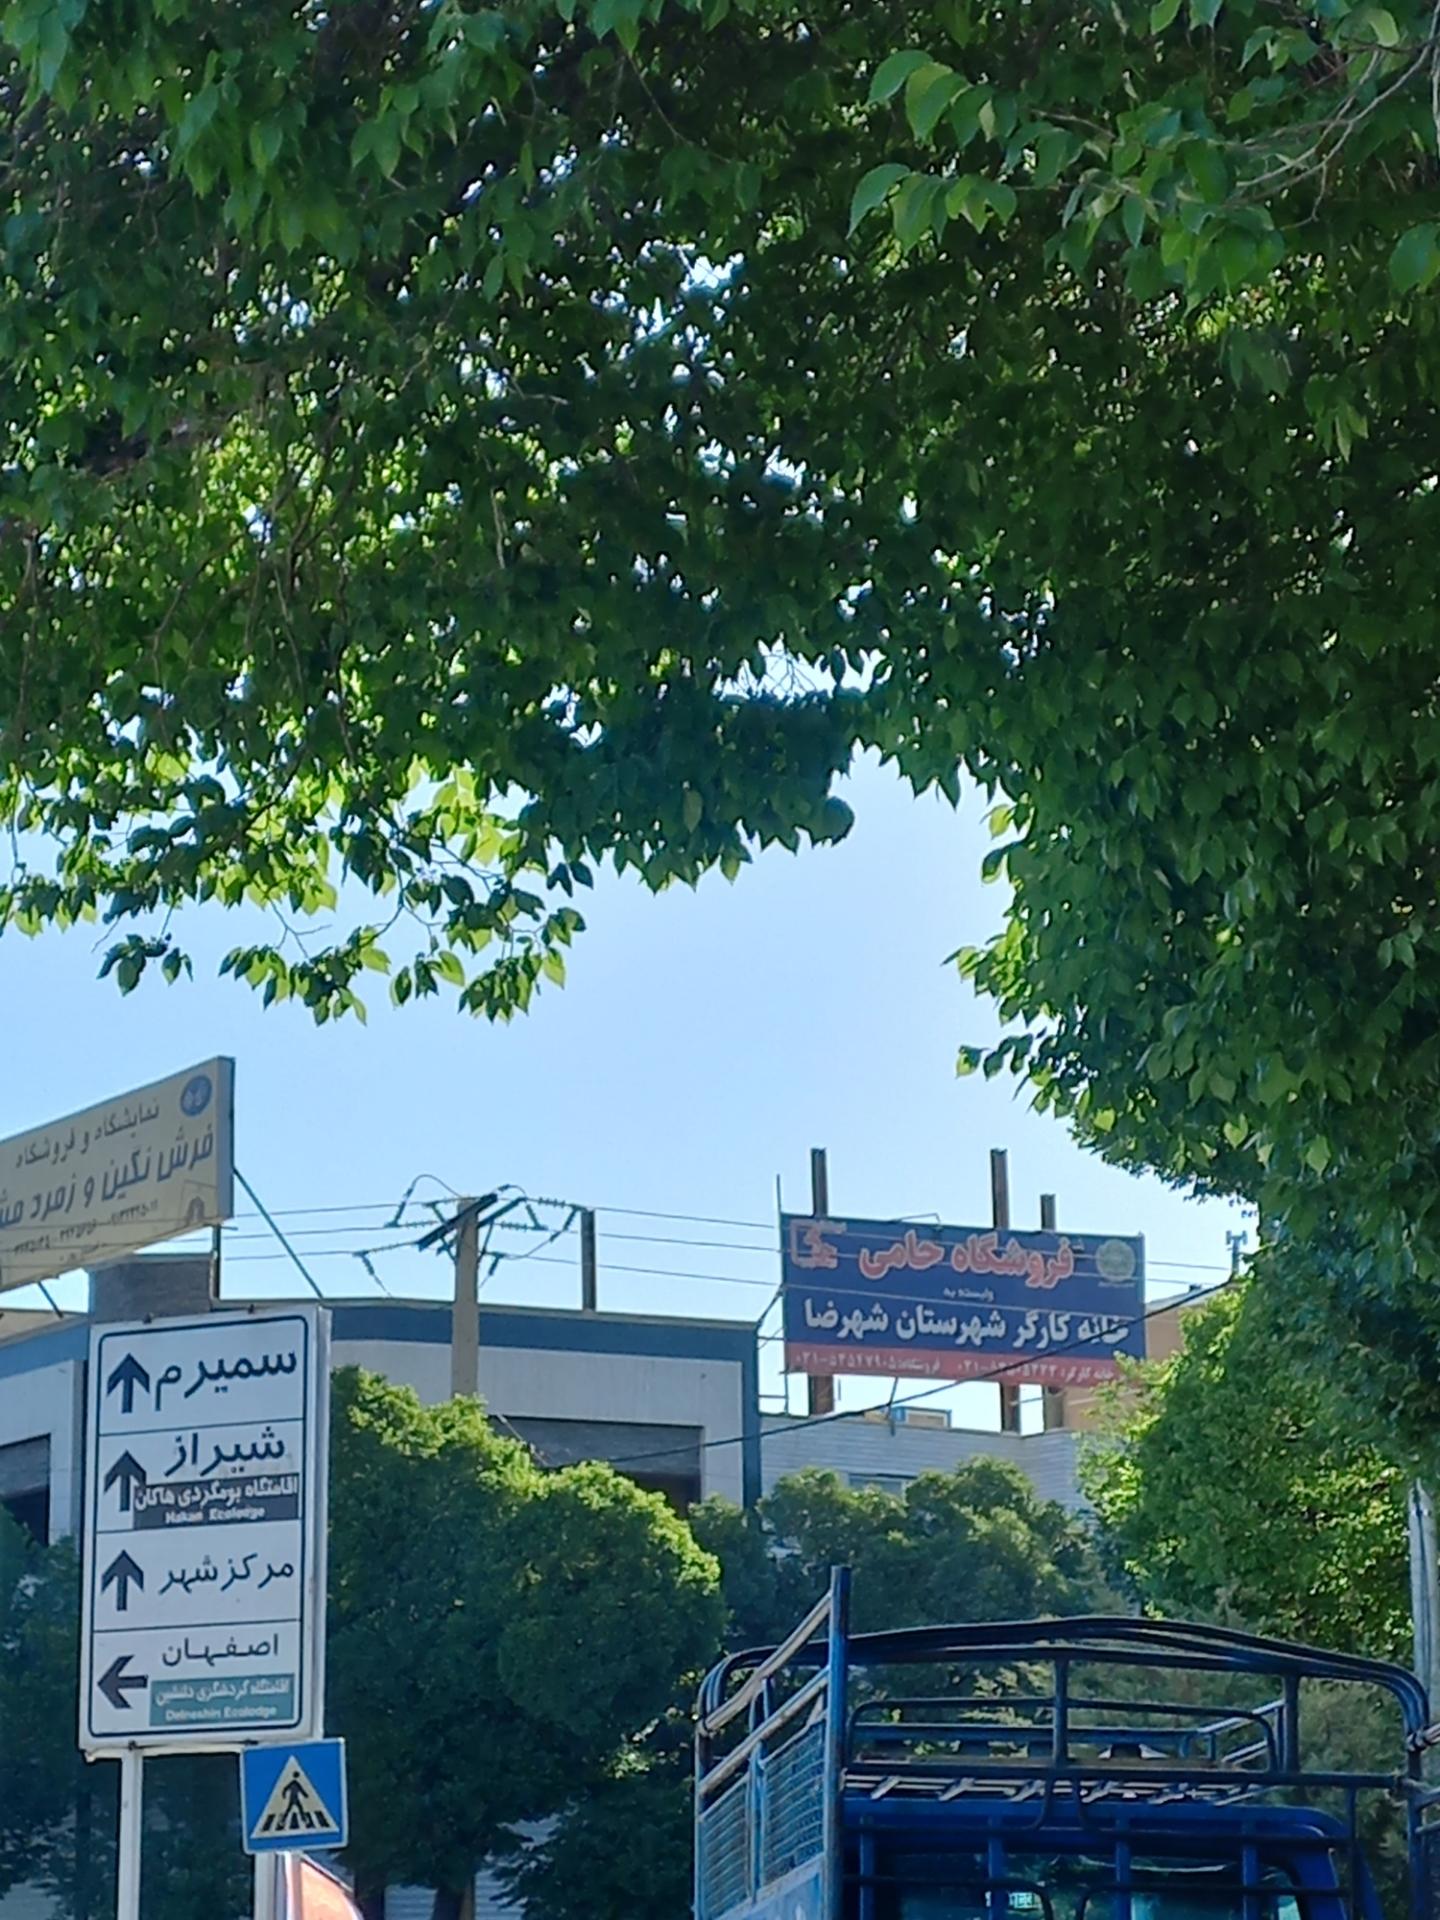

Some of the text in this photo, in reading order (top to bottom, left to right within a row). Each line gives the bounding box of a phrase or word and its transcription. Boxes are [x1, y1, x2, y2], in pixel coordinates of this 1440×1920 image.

[80, 1131, 90, 1154] و
[157, 1123, 214, 1182] فرش
[30, 1172, 76, 1222] زمرد
[84, 1176, 95, 1208] و
[101, 1146, 151, 1202] نگین
[0, 1187, 24, 1228] مش
[858, 1229, 945, 1280] حامی
[952, 1232, 1073, 1288] فروشگاه
[943, 1286, 956, 1298] به
[804, 1298, 1129, 1349] خانه کارگر شهرستان شهرضا
[155, 1350, 297, 1411] سمیرم
[164, 1426, 285, 1477] شیراز
[135, 1476, 298, 1511] اقامتگاه بومگردی هاکان
[162, 1634, 279, 1667] اصفهان
